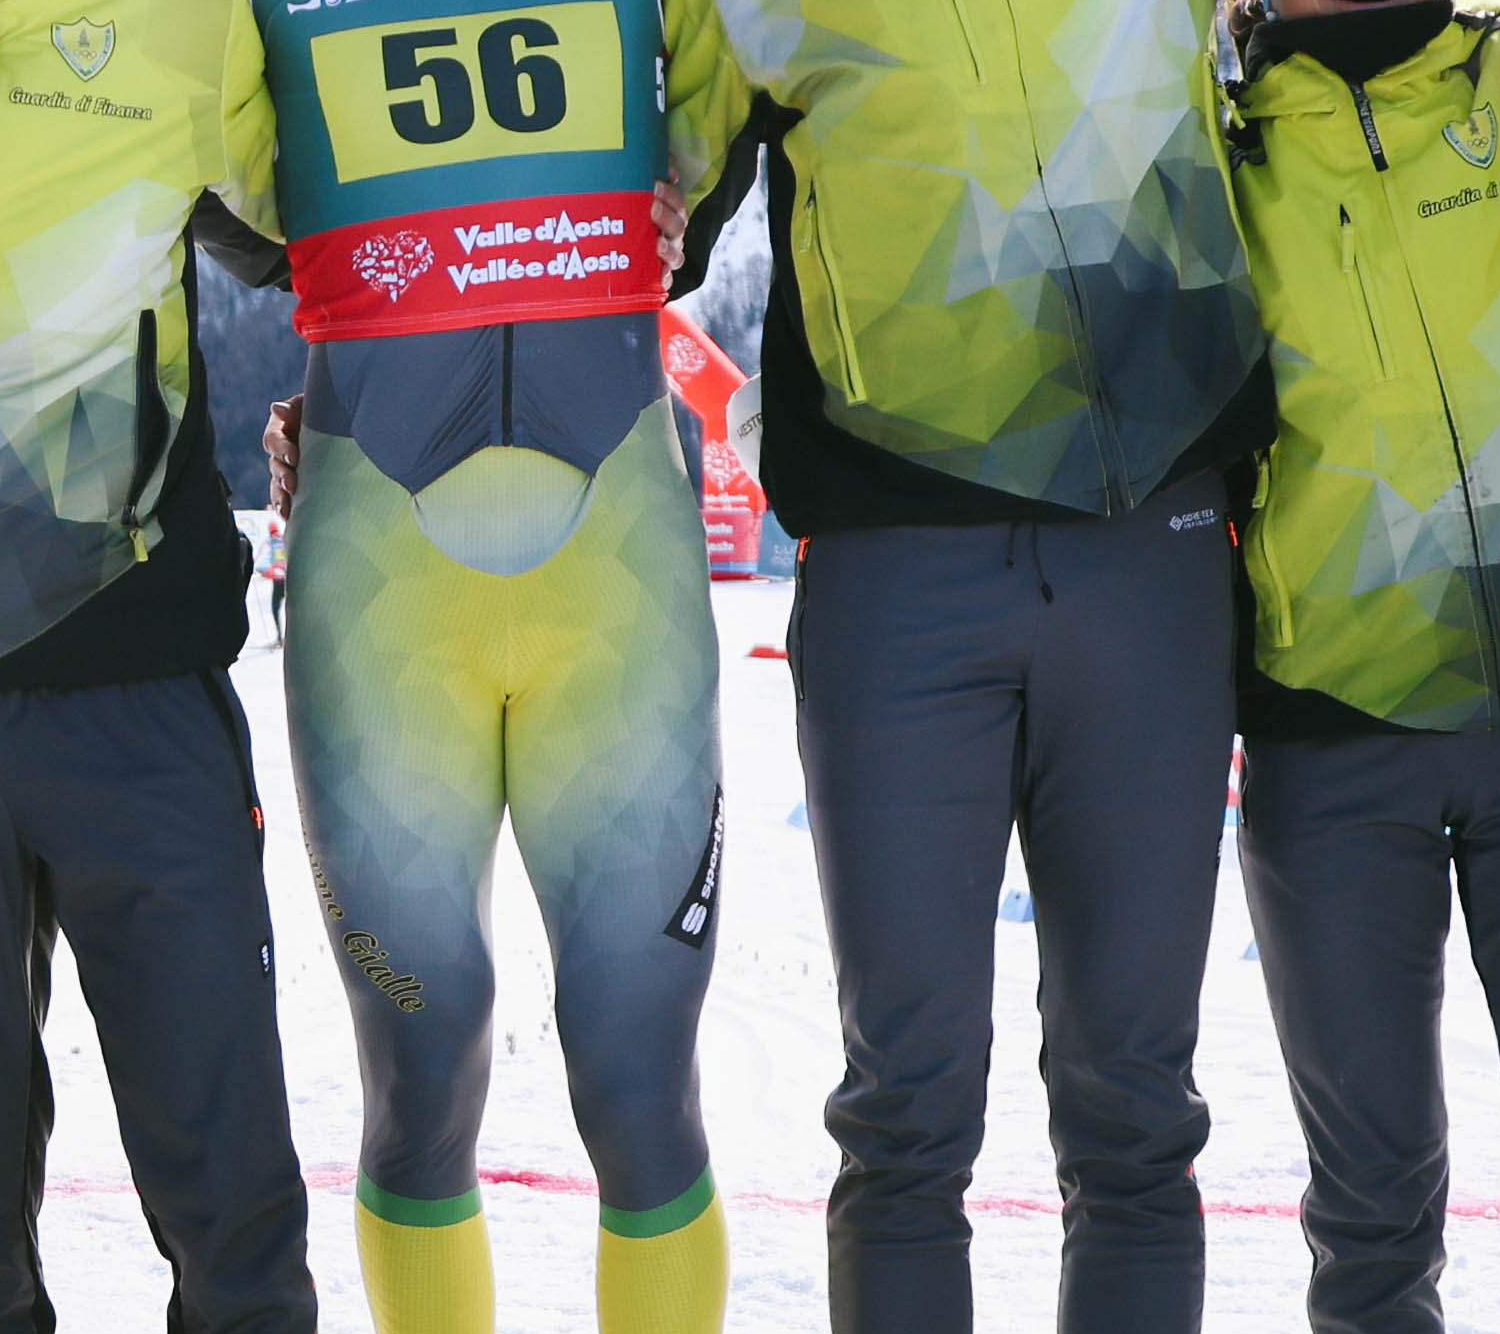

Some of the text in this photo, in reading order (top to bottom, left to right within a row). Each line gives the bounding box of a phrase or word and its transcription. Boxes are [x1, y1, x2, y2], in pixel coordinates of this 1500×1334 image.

[9, 86, 153, 122] Guardia di Finanza
[381, 17, 567, 144] 56
[1418, 187, 1482, 218] Guardia
[1485, 182, 1499, 199] di
[453, 209, 626, 256] Valle d'Aosta
[447, 246, 632, 294] Vallée d'Aoste
[344, 930, 426, 1015] Gialle
